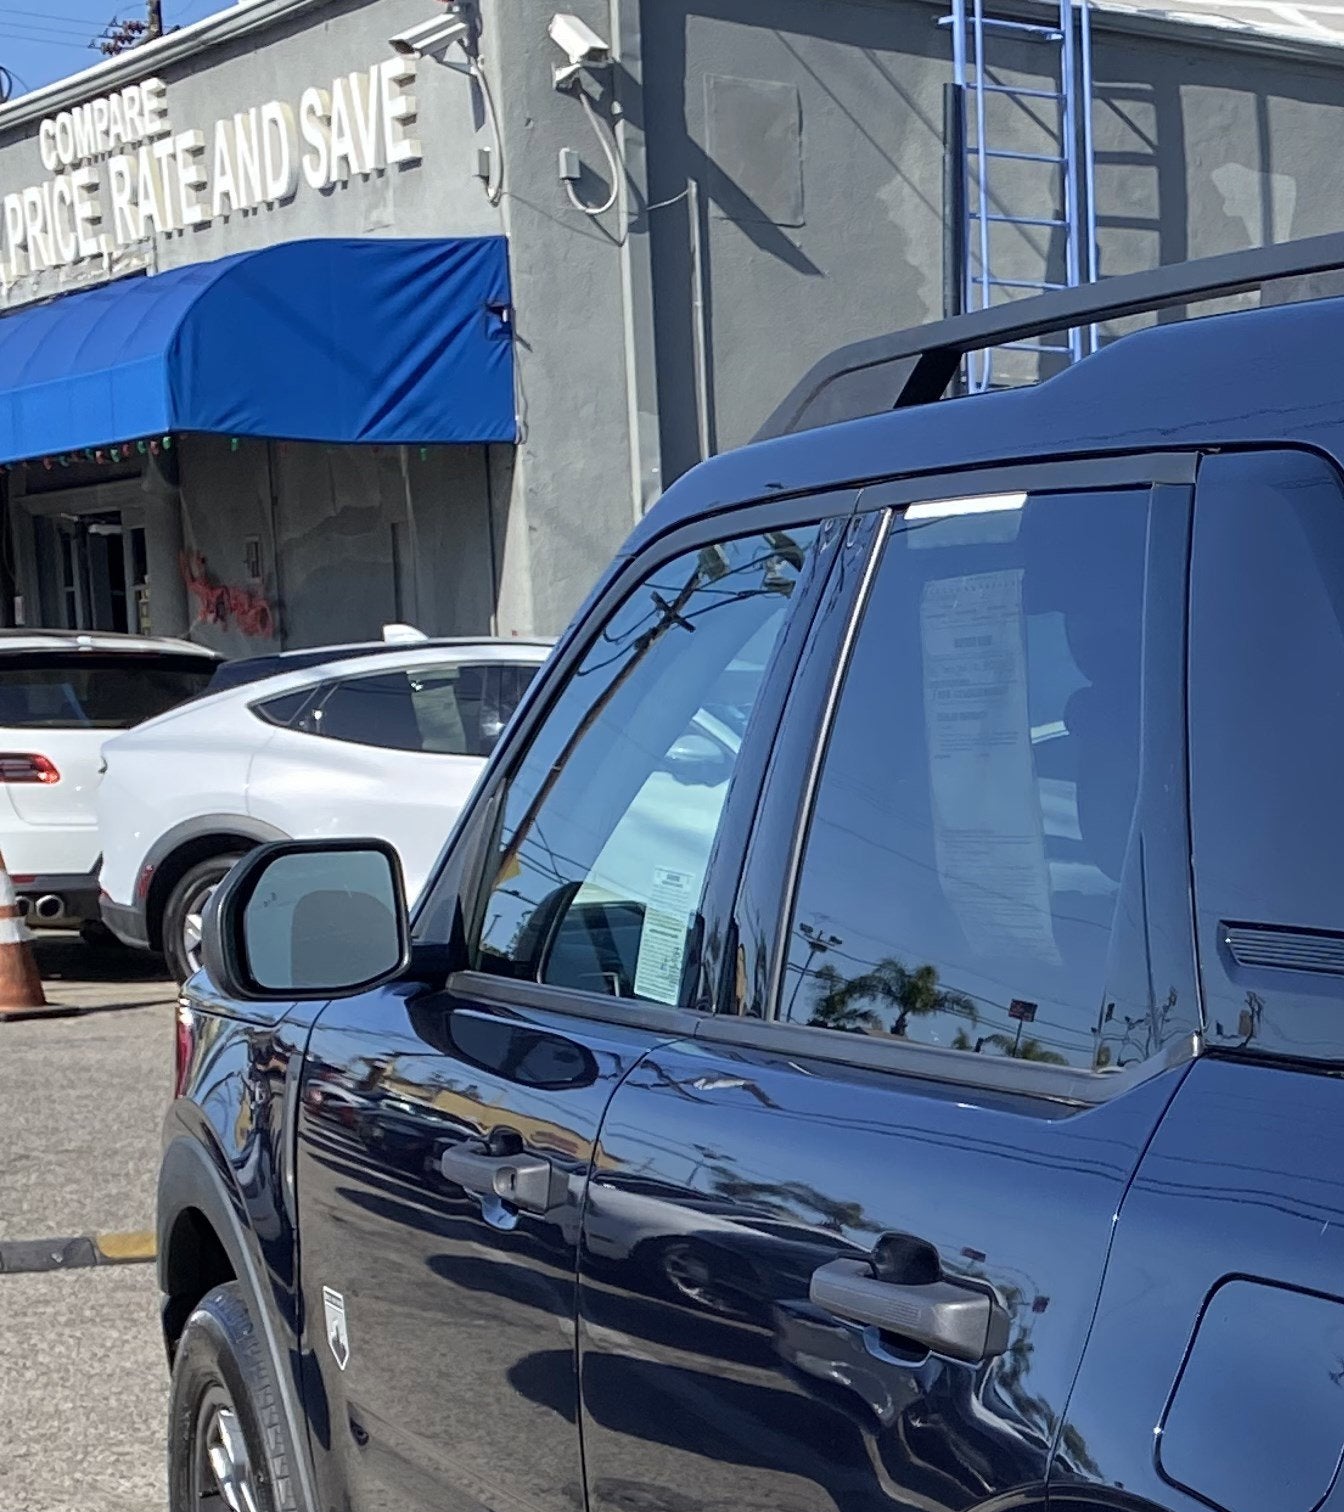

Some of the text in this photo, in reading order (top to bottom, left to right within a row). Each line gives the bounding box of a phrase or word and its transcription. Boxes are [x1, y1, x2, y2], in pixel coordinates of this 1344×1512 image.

[39, 77, 168, 171] COMPARE
[108, 128, 207, 244] RATE
[212, 100, 298, 217] AND
[300, 57, 424, 191] SAVE
